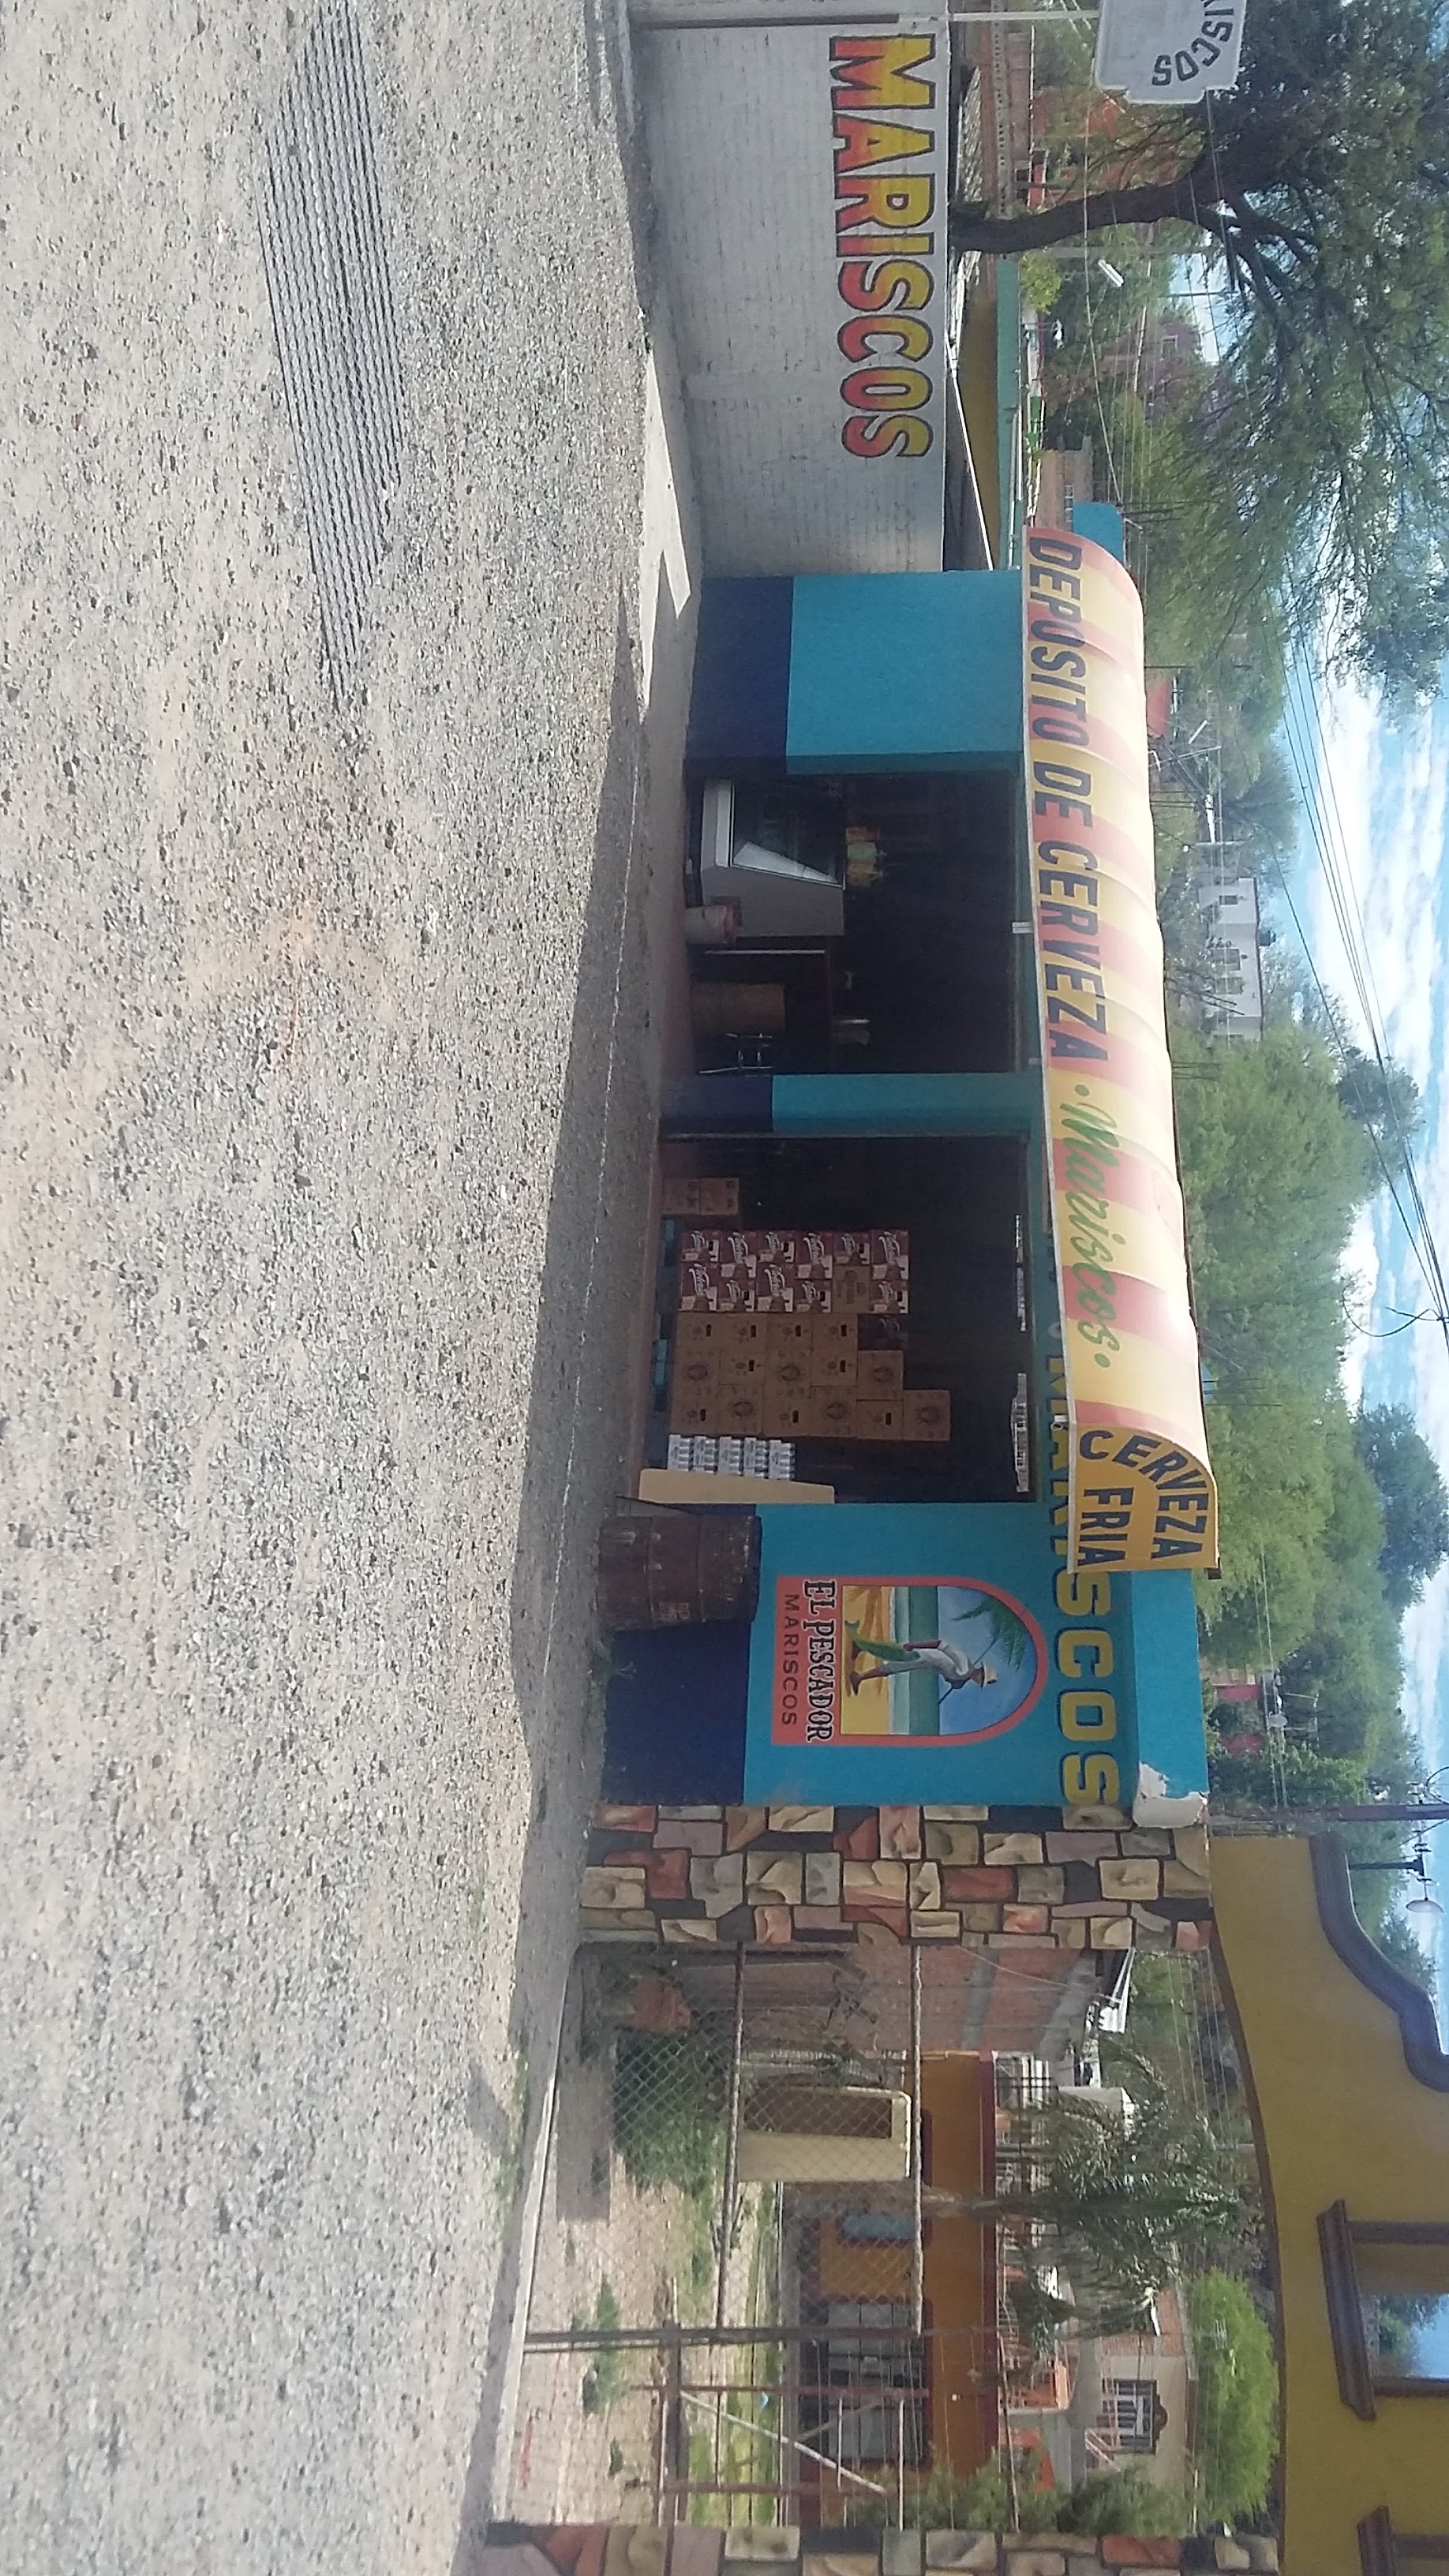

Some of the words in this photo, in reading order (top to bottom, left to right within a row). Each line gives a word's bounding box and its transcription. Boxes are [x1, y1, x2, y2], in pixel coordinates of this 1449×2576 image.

[1151, 0, 1236, 87] ISCOS
[829, 33, 937, 459] MARISCOS
[1028, 536, 1090, 747] DEPOSITO
[1032, 761, 1094, 829] DE
[1037, 841, 1109, 1061] CERVEZA
[1060, 1103, 1126, 1352] Mariscos
[1076, 1487, 1135, 1567] FRIA
[1079, 1430, 1209, 1560] CERVEZA
[781, 1593, 801, 1727] MARISCOS
[803, 1579, 837, 1616] EL
[802, 1619, 837, 1743] PESCADOR
